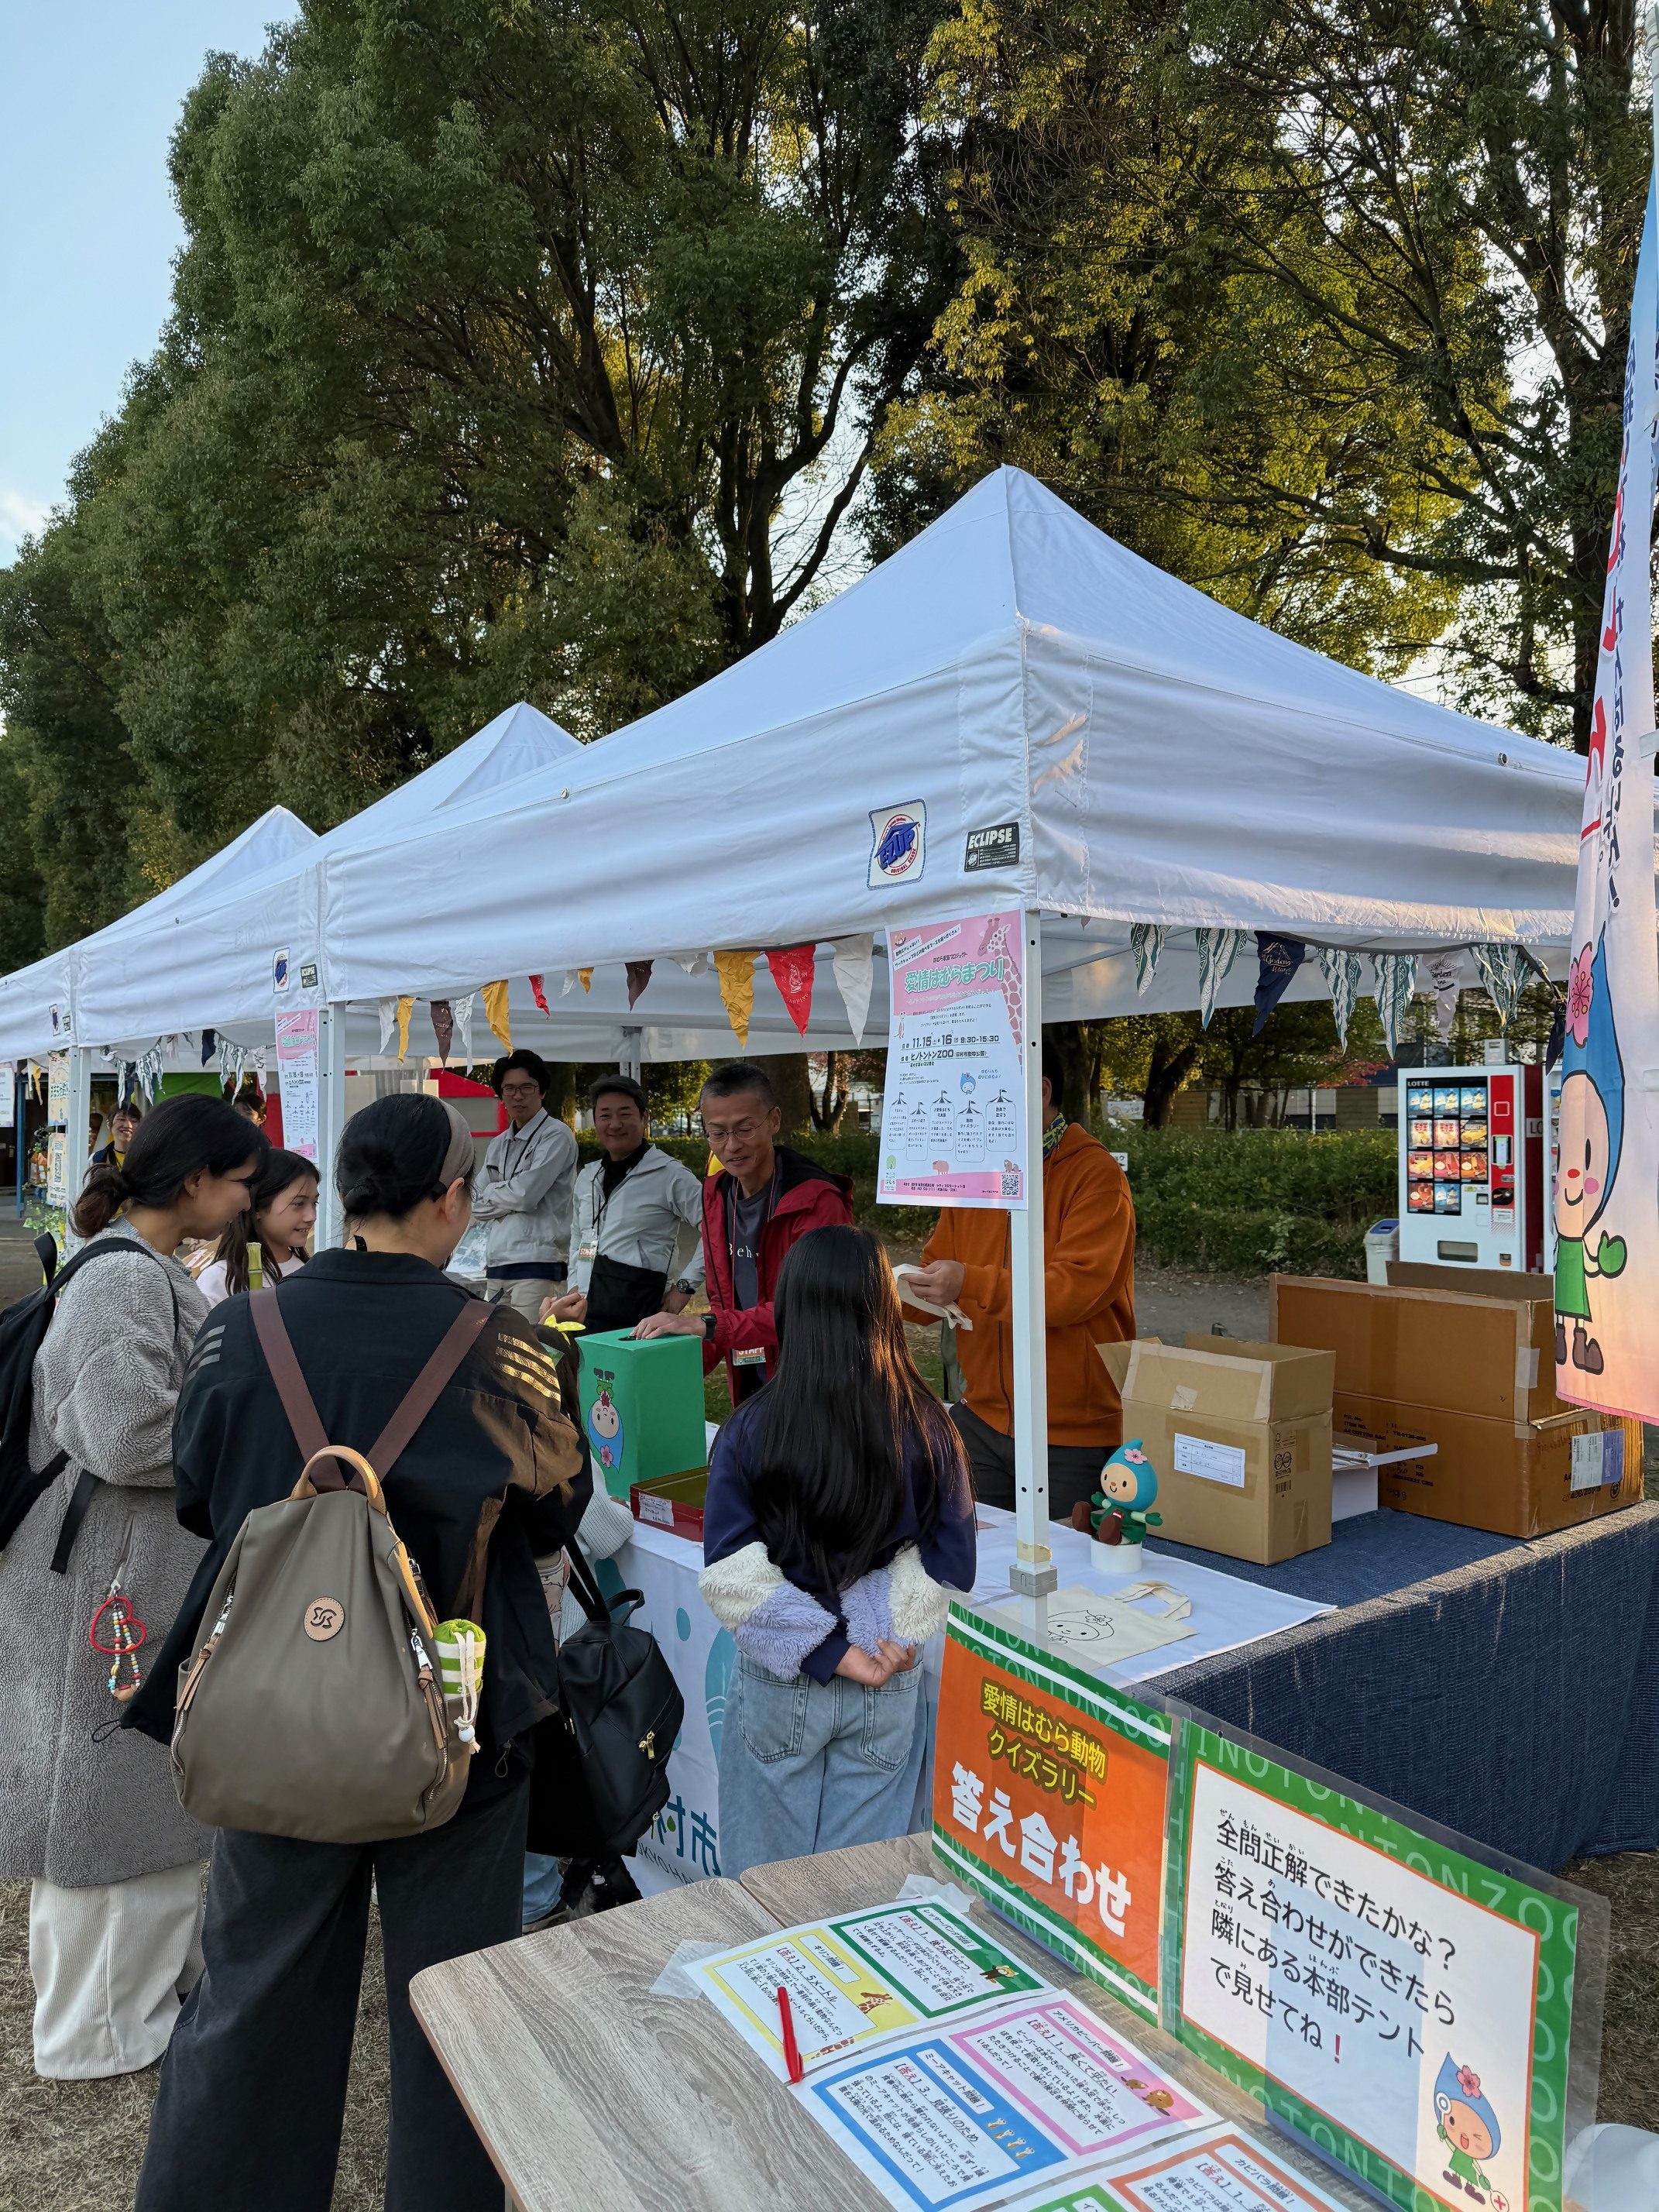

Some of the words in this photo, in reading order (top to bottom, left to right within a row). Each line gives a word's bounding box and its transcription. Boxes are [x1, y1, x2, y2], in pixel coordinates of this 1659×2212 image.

[968, 827, 1013, 850] ECLIPSE
[905, 958, 1005, 994] 愛情はむらまつり
[984, 1683, 1105, 1778] 愛情はむら動物
[991, 1729, 1094, 1803] クイズラリー
[951, 1760, 1132, 1937] 答え合わせ
[1266, 1832, 1279, 1843] せい
[1288, 1843, 1304, 1855] かい
[1217, 1819, 1455, 1970] 全問正解できたかな?
[1211, 1908, 1424, 2057] 隣にある本部テント
[1214, 1862, 1455, 2025] 答え合わせができたら
[1211, 1957, 1341, 2063] で見せてね!
[922, 2052, 986, 2108] ミーアキャット問題!
